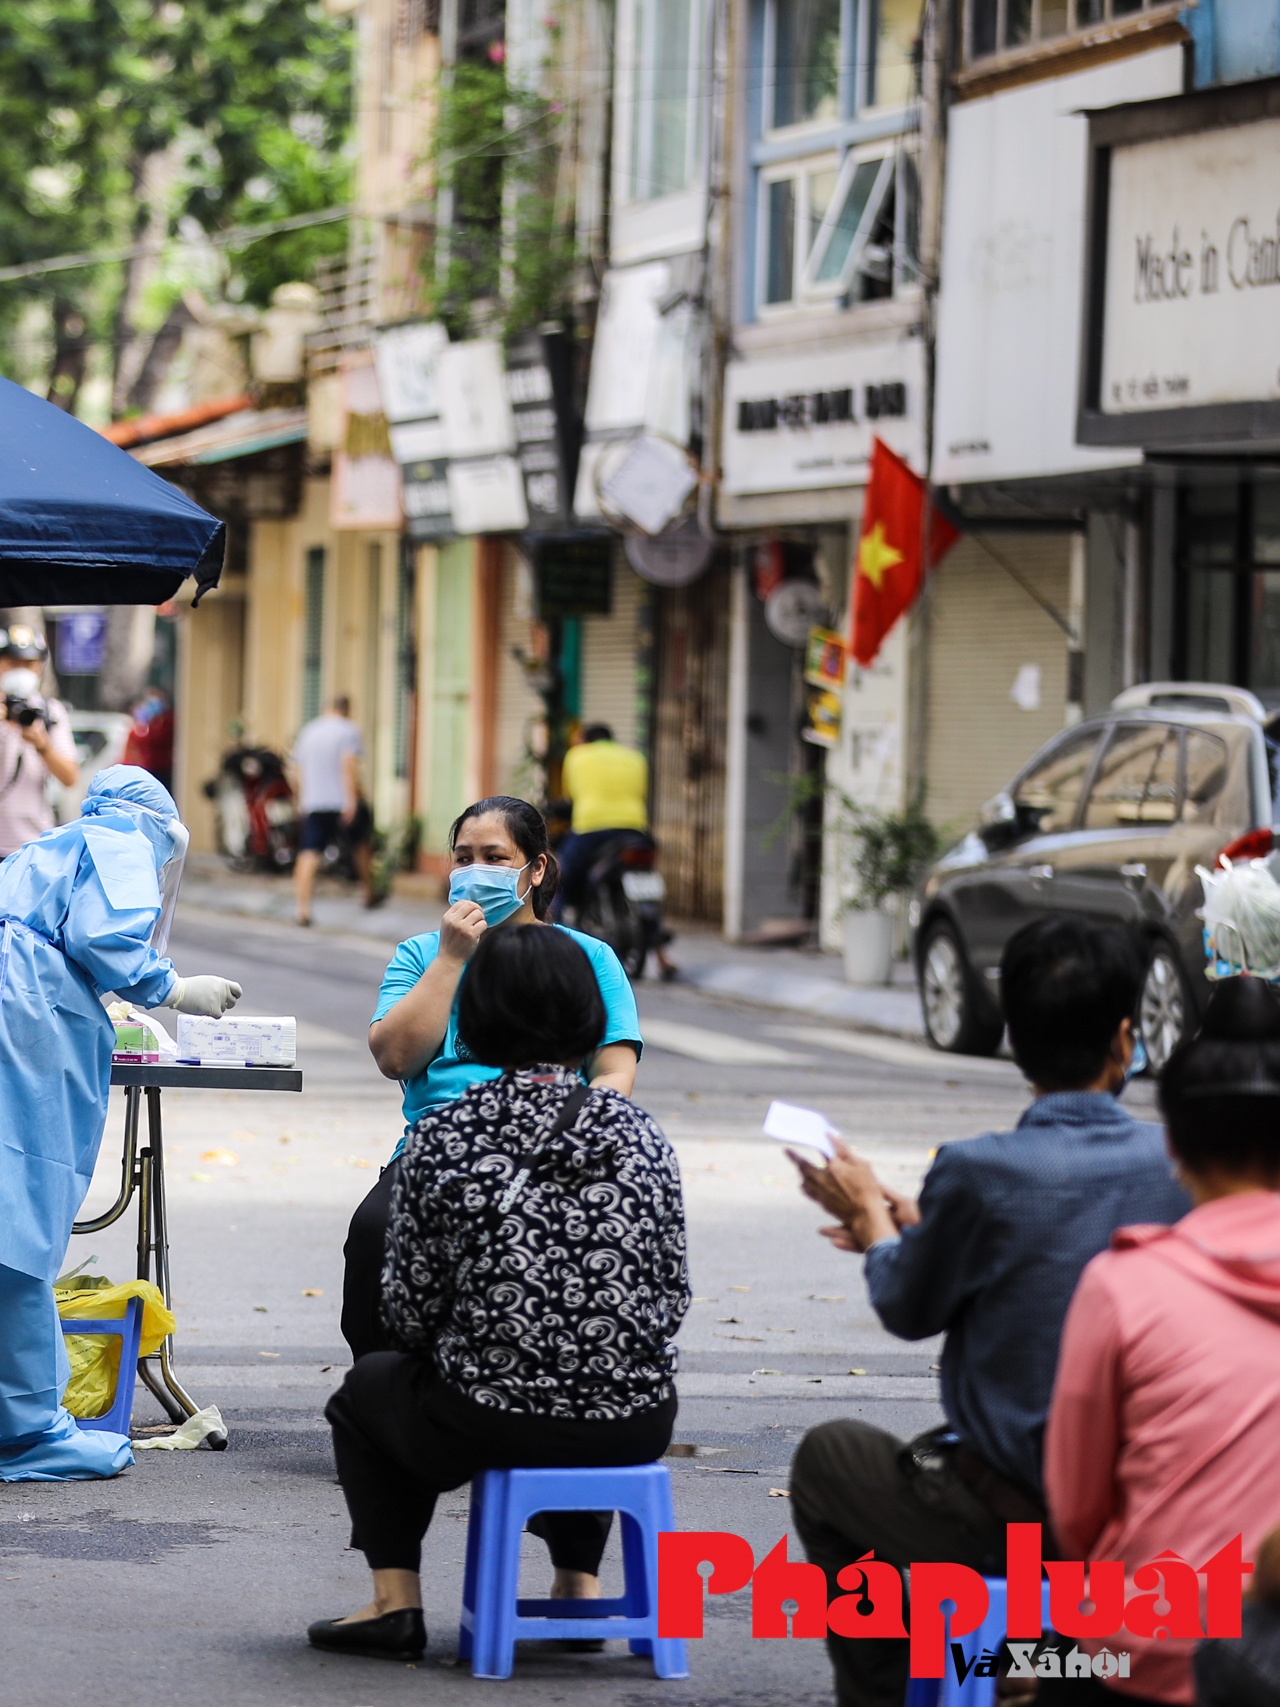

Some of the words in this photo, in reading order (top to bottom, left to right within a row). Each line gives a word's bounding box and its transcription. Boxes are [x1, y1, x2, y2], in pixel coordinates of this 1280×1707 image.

[1133, 223, 1193, 305] Made
[1199, 228, 1220, 295] in
[498, 1168, 531, 1214] adidas
